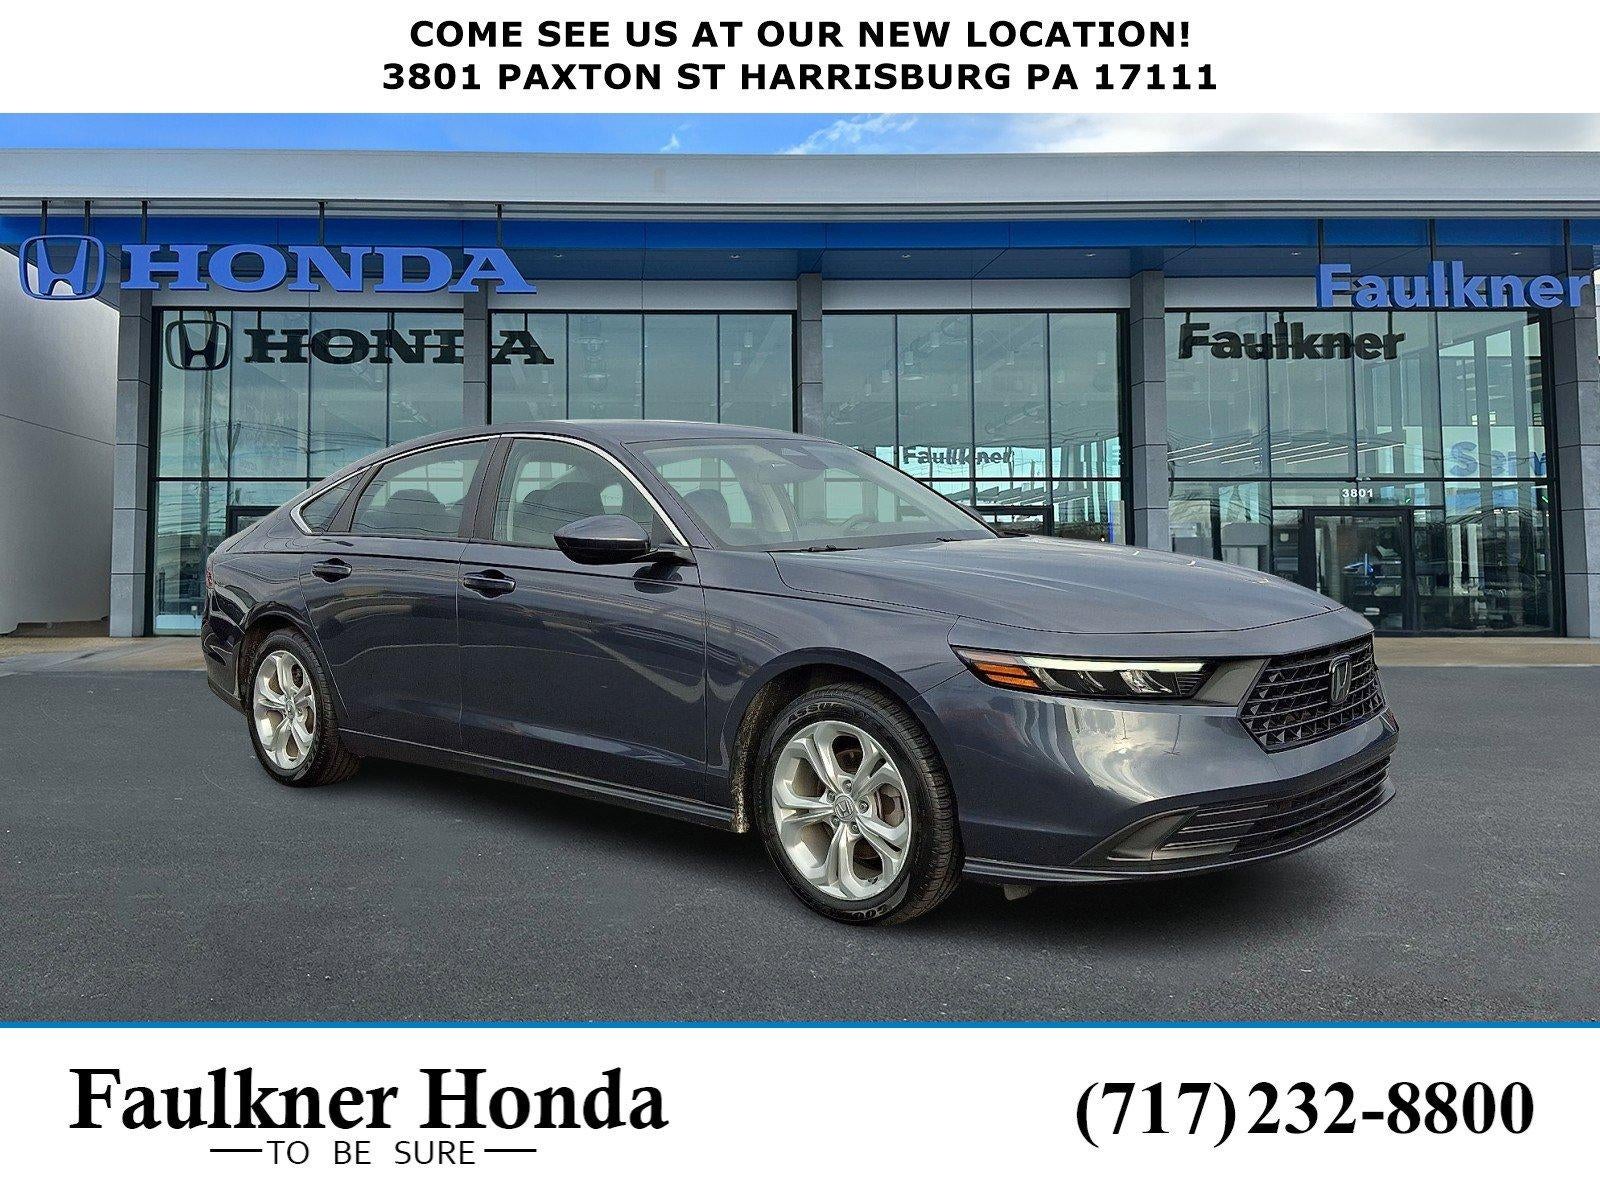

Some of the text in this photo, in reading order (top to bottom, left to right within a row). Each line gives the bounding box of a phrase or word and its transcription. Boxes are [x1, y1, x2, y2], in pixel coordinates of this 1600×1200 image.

[120, 243, 537, 295] HONDA
[1317, 260, 1591, 309] Faulkner
[1178, 321, 1406, 360] Faulkner
[1341, 488, 1374, 498] 3801
